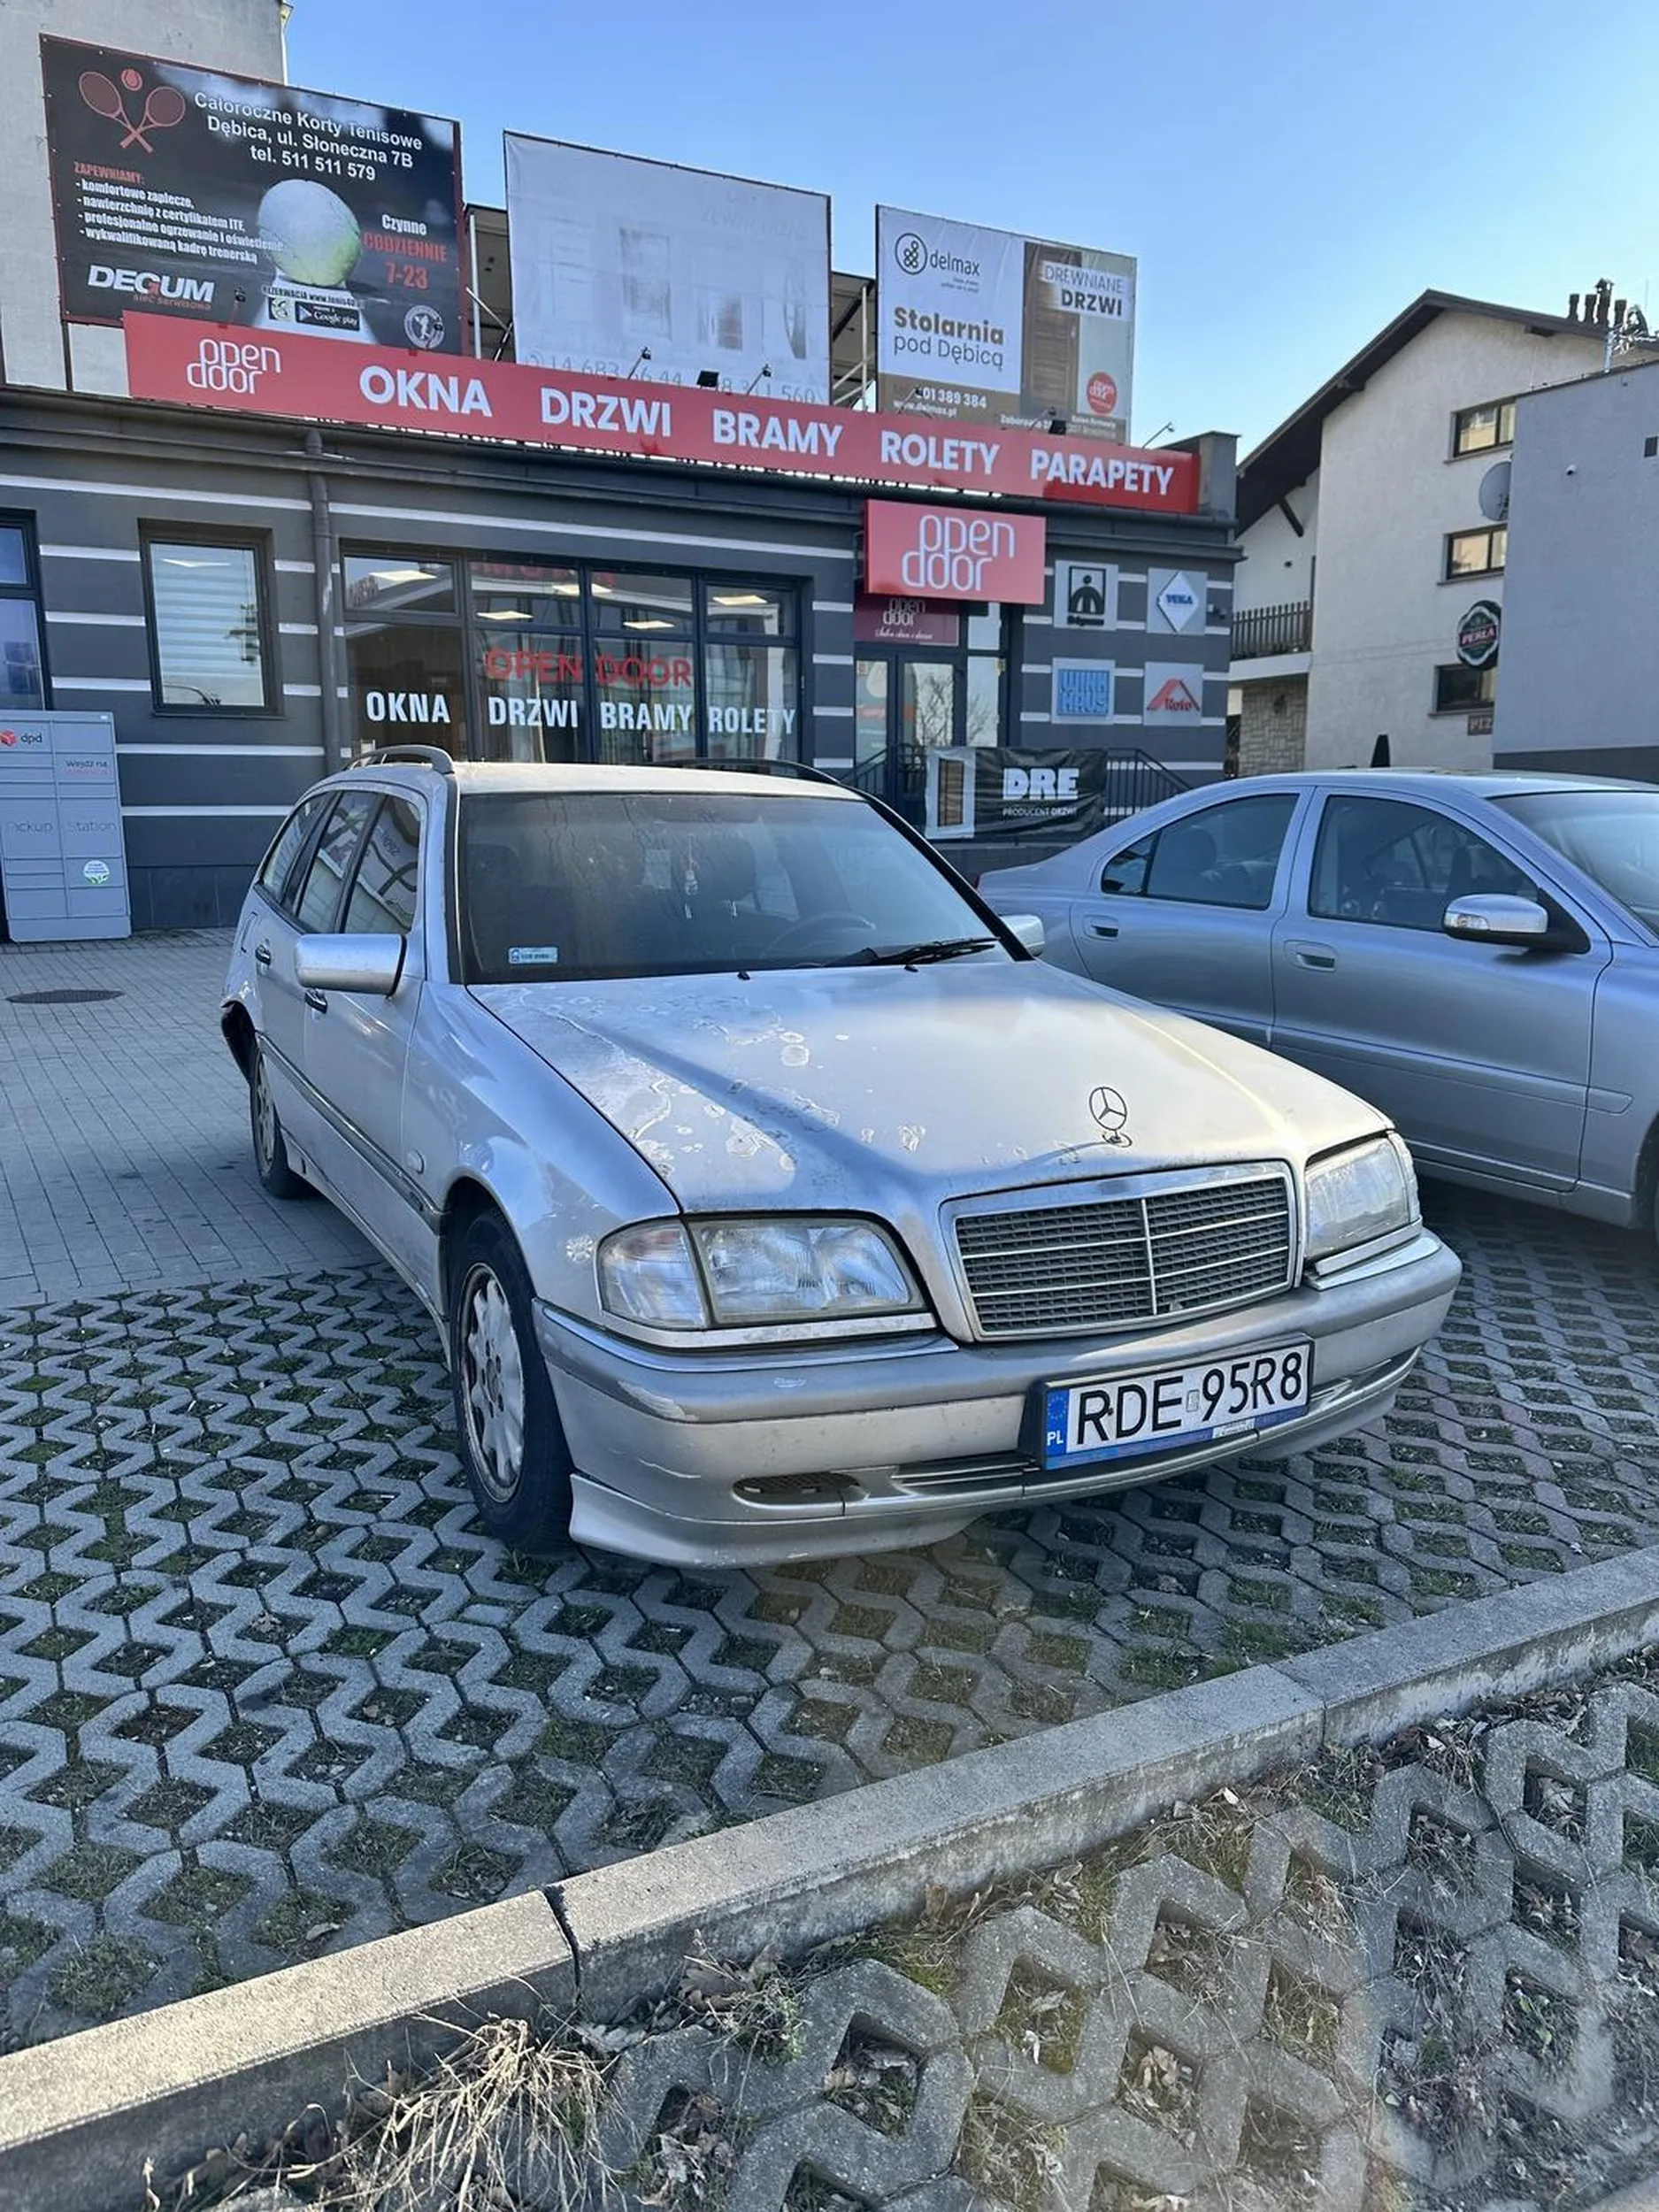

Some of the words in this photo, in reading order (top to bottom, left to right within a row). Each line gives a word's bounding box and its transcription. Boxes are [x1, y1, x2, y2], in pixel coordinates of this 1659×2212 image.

[194, 91, 292, 126] Całoroczne
[297, 111, 342, 137] Korty
[348, 122, 423, 150] Tenisowe
[207, 115, 273, 144] Dębica,
[277, 130, 297, 148] ul.
[302, 134, 388, 165] Słoneczna
[391, 150, 413, 169] 7B
[250, 145, 277, 164] tel.
[281, 150, 309, 170] 511
[314, 156, 342, 176] 511
[347, 161, 376, 181] 579
[381, 213, 427, 236] Czynne
[364, 233, 449, 263] CODZIENNIE
[929, 249, 980, 276] delmax
[88, 265, 215, 303] DEGUM
[385, 261, 429, 290] 7-23
[1044, 265, 1125, 294] DREWNIANE
[1061, 288, 1123, 317] DRZWI
[313, 311, 342, 325] Google
[342, 317, 359, 327] play
[894, 306, 1004, 345] Stolarnia
[894, 334, 932, 356] pod
[938, 339, 1003, 372] Dębicą
[937, 388, 962, 405] 389
[963, 391, 987, 409] 384
[359, 365, 492, 419] OKNA
[541, 387, 671, 437] DRZWI
[712, 409, 843, 457] BRAMY
[880, 430, 1001, 475] ROLETY
[1030, 449, 1174, 495] PARAPETY
[486, 649, 581, 683] OPEN
[596, 655, 692, 687] DOOR
[366, 691, 451, 723] OKNA
[488, 697, 579, 728] DRZWI
[600, 702, 693, 733] BRAMY
[708, 707, 796, 735] ROLETY
[20, 733, 42, 745] dpd
[1002, 767, 1079, 801] DRE
[67, 820, 117, 833] Station
[1078, 1375, 1184, 1445] RDE
[1202, 1351, 1302, 1422] 95R8
[1047, 1431, 1064, 1447] PL
